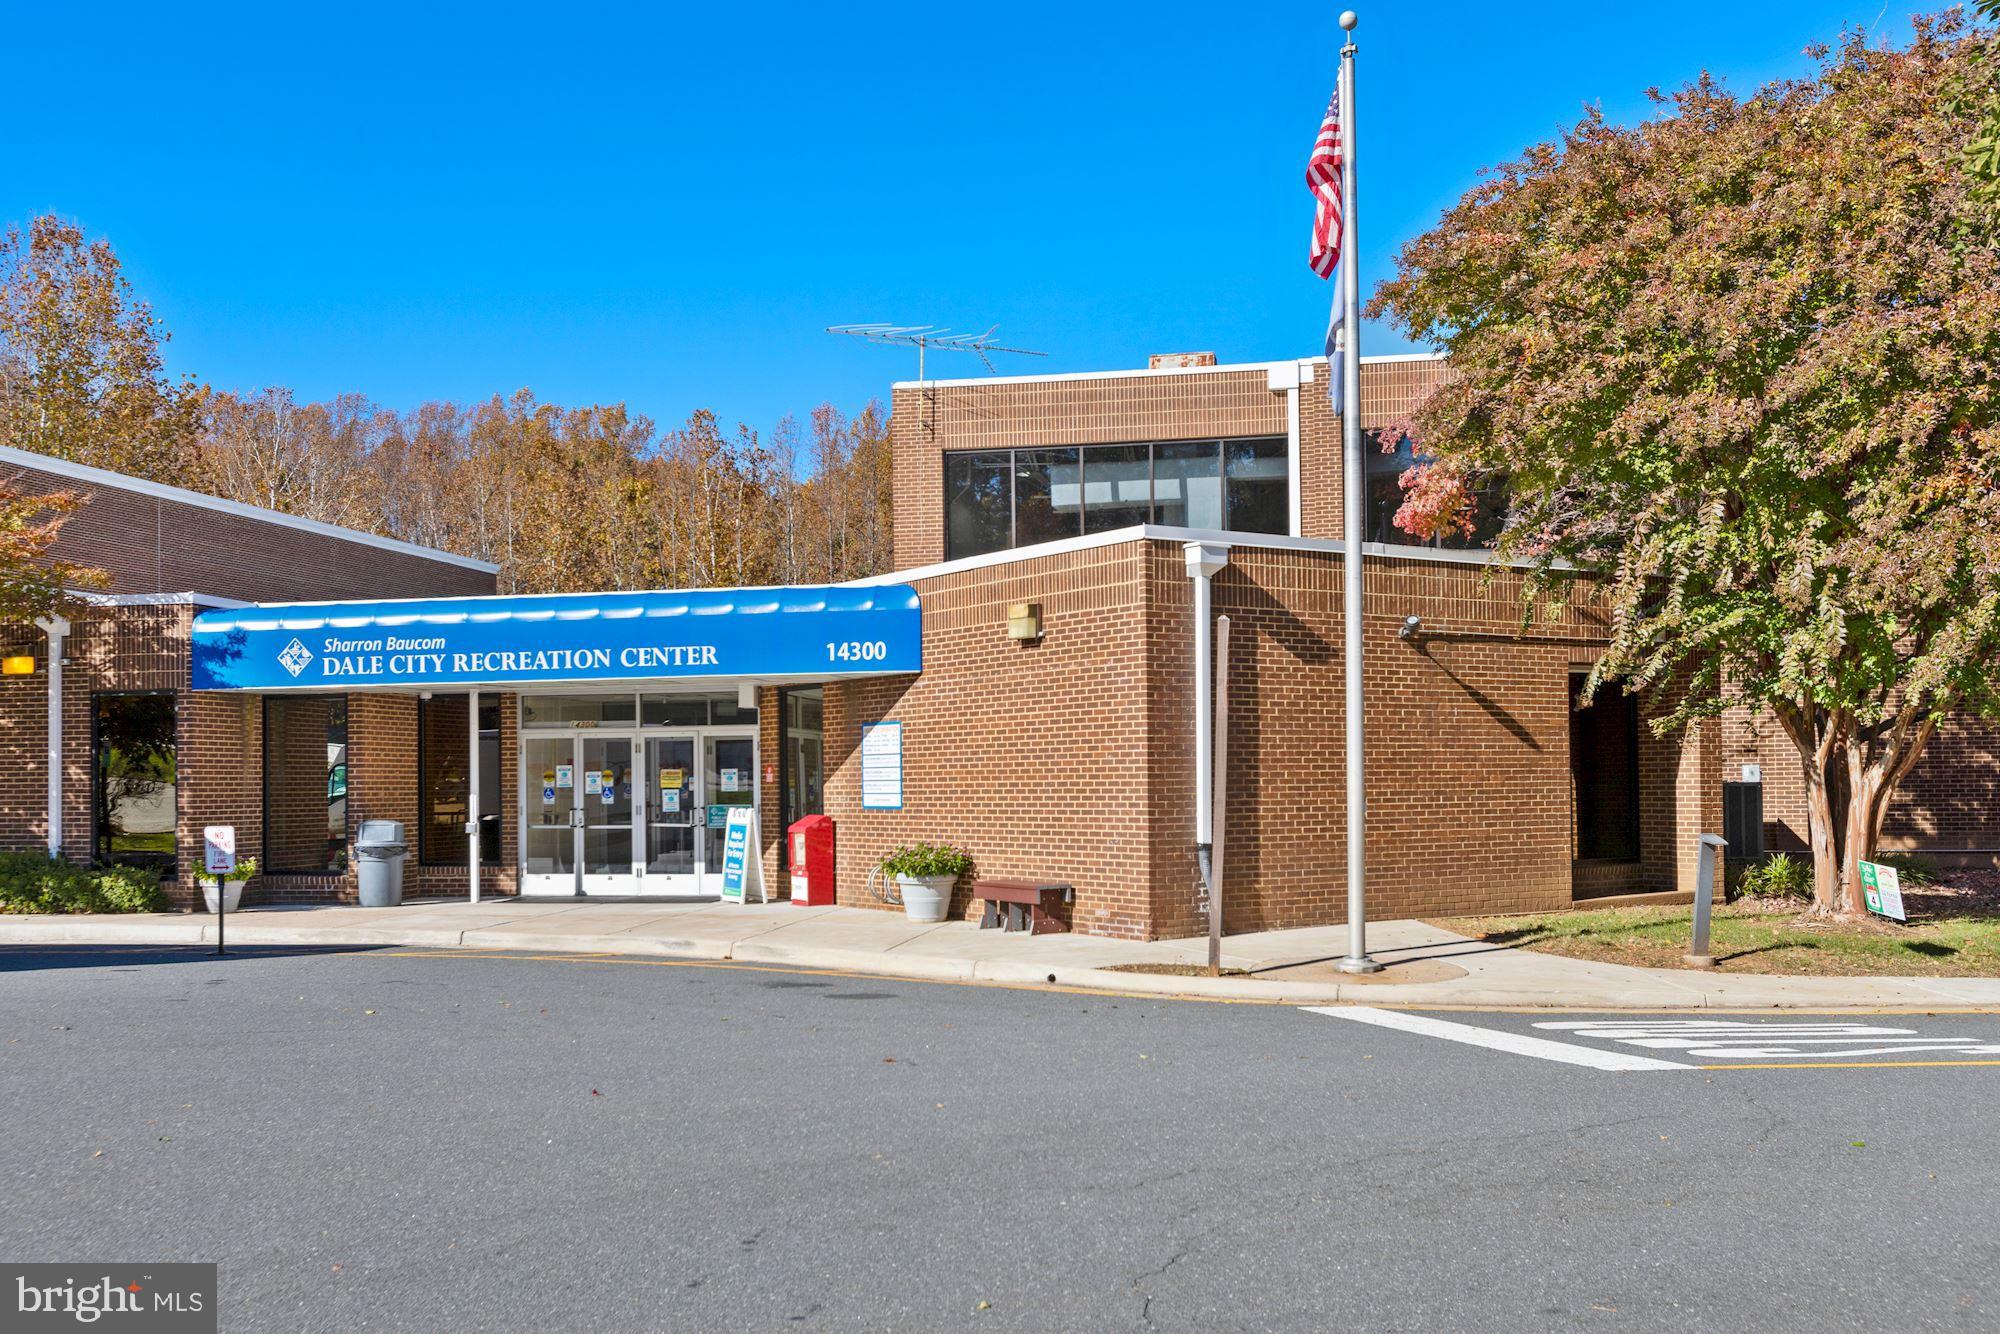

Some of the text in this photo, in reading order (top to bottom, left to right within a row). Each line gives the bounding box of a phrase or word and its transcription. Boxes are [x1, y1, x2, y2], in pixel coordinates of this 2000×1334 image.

[324, 637, 446, 653] Sharron Baucom
[826, 641, 887, 661] 14300
[322, 646, 719, 676] DALE CITY RECREATION CENTER
[214, 831, 224, 839] NO
[1531, 1020, 2000, 1058] STOP
